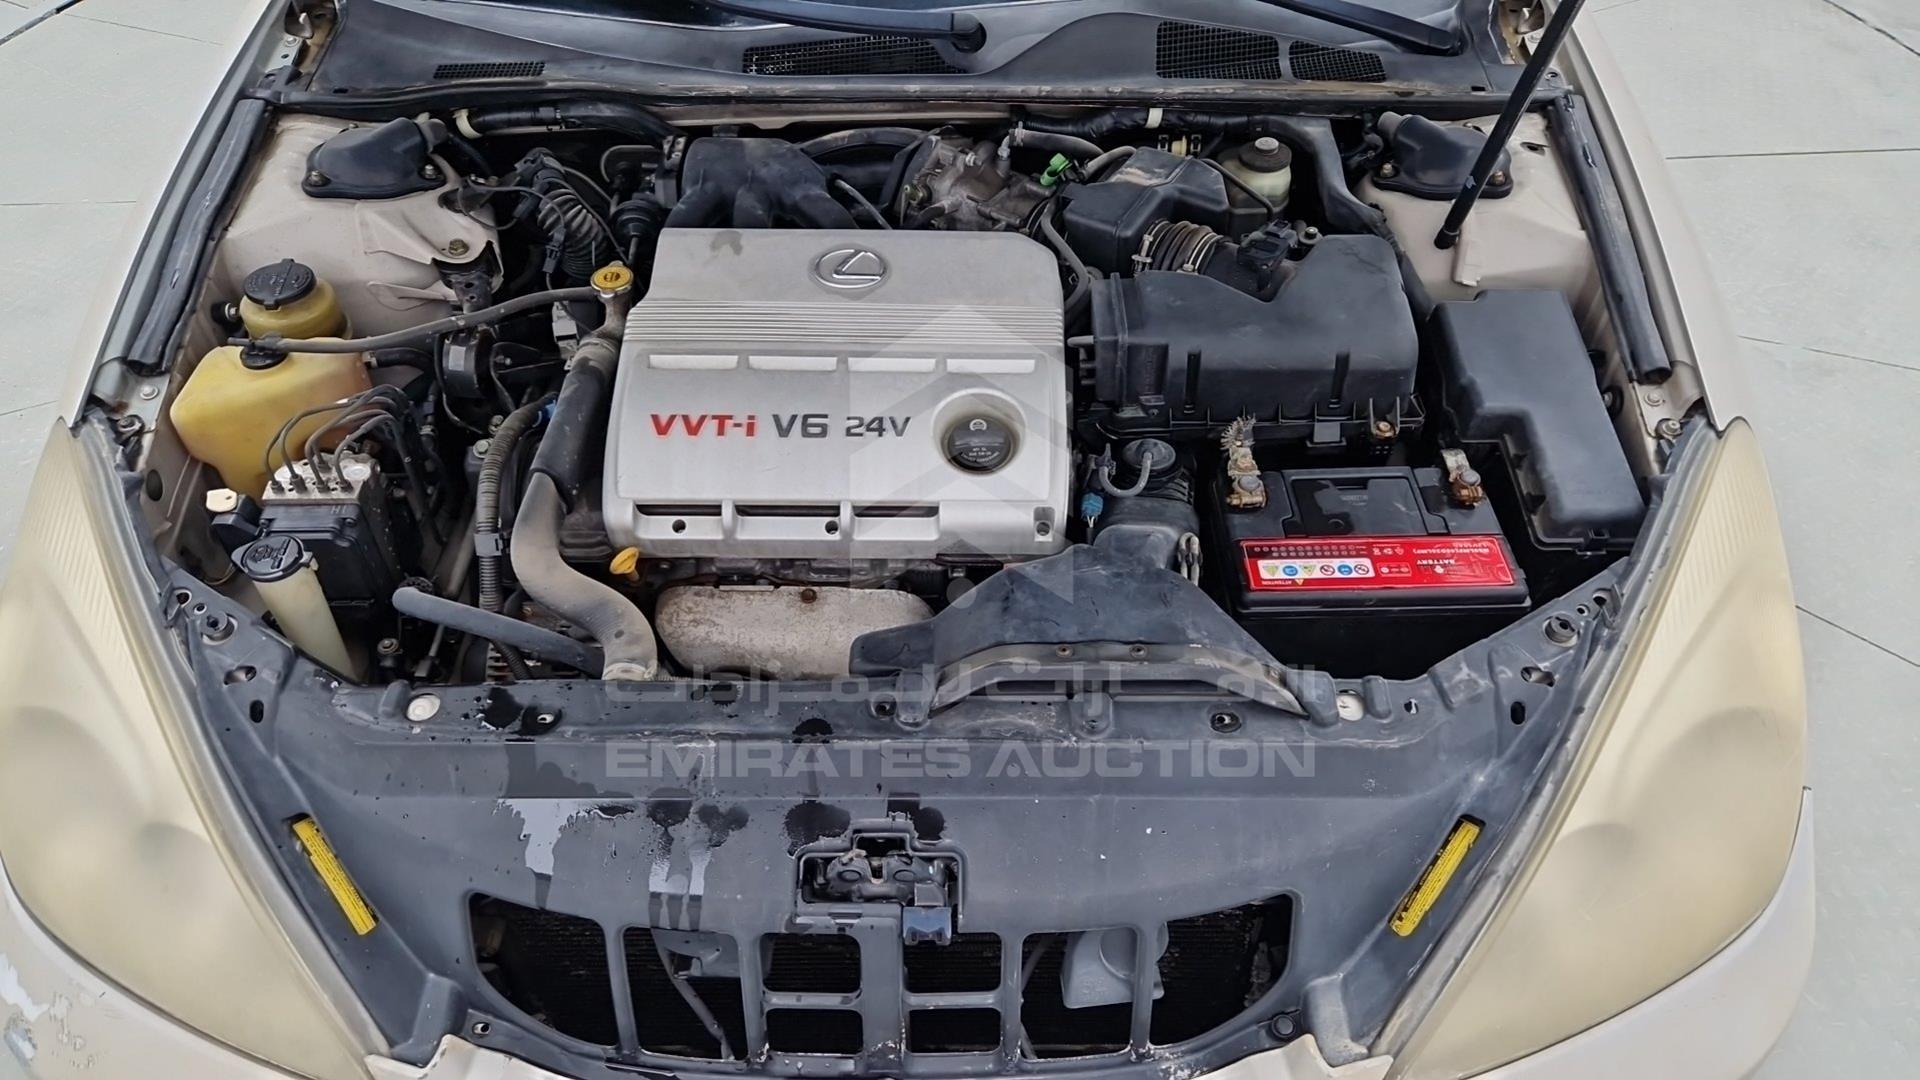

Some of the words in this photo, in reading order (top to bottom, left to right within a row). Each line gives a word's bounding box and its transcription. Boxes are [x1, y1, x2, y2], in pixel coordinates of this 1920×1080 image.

[651, 414, 756, 437] VVT-i
[773, 414, 829, 438] V6
[845, 416, 911, 437] 24V
